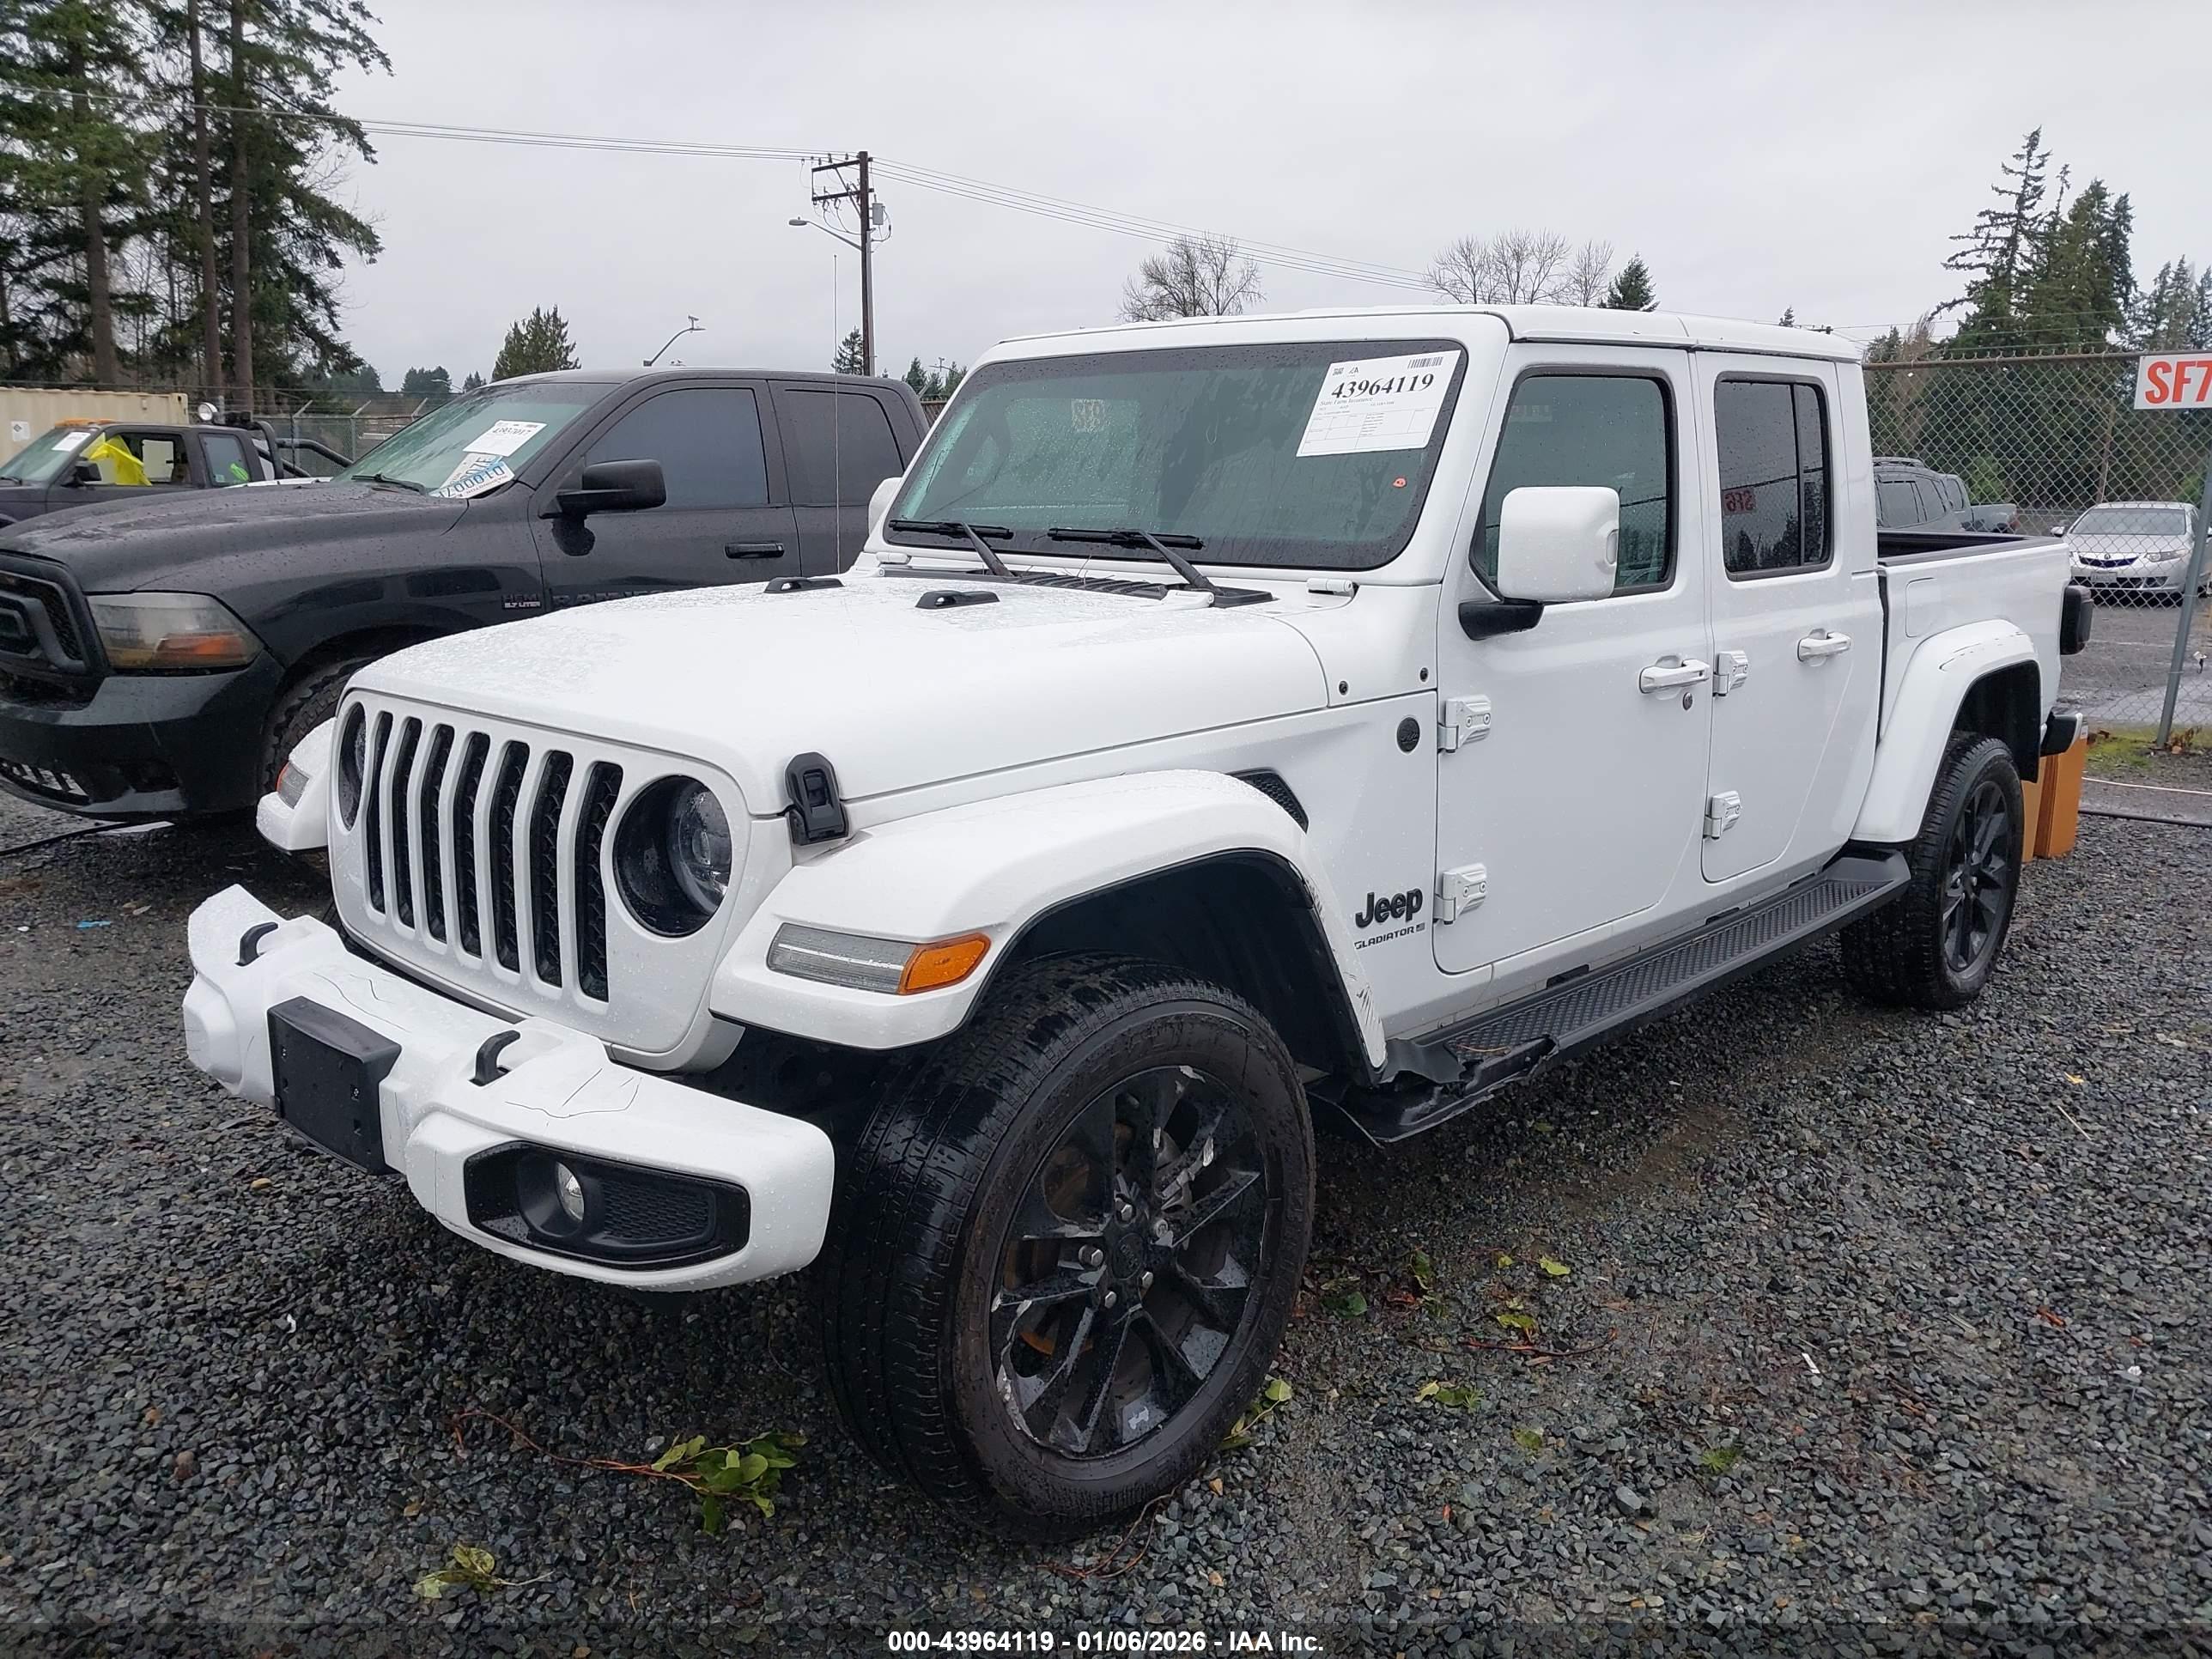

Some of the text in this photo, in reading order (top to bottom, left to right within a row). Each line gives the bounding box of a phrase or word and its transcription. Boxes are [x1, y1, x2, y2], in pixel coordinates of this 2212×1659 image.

[1332, 374, 1434, 398] 43964119
[2145, 361, 2212, 404] SF7
[1355, 888, 1423, 929] Jeep
[1354, 927, 1415, 950] GLADIATOR
